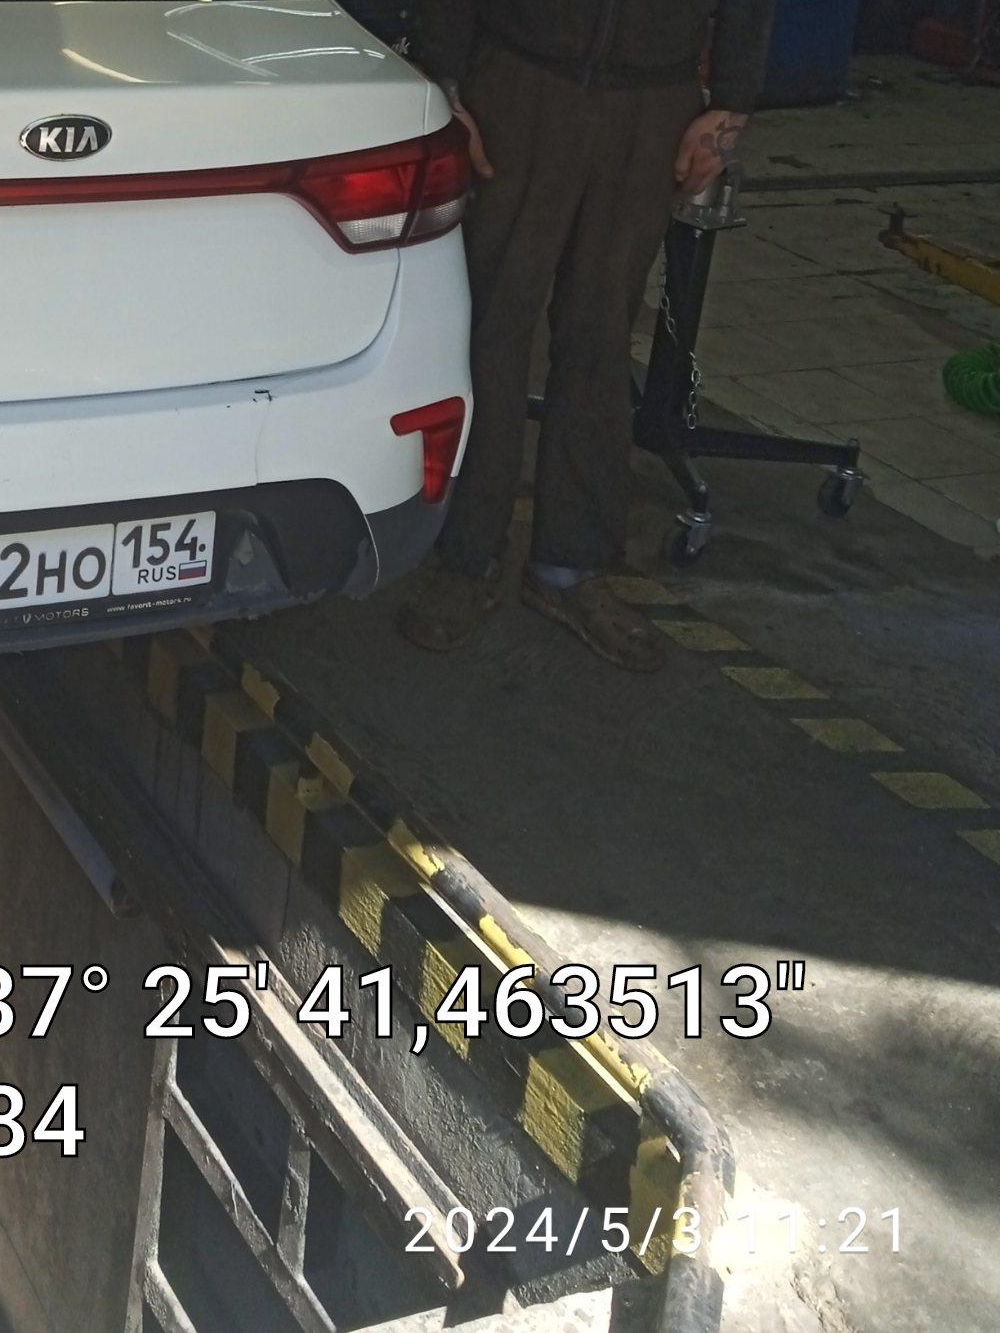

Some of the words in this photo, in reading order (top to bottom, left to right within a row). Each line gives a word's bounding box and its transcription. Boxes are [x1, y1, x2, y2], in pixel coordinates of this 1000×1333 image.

[38, 126, 99, 153] KIA
[121, 519, 198, 569] 154
[137, 566, 177, 585] RUS
